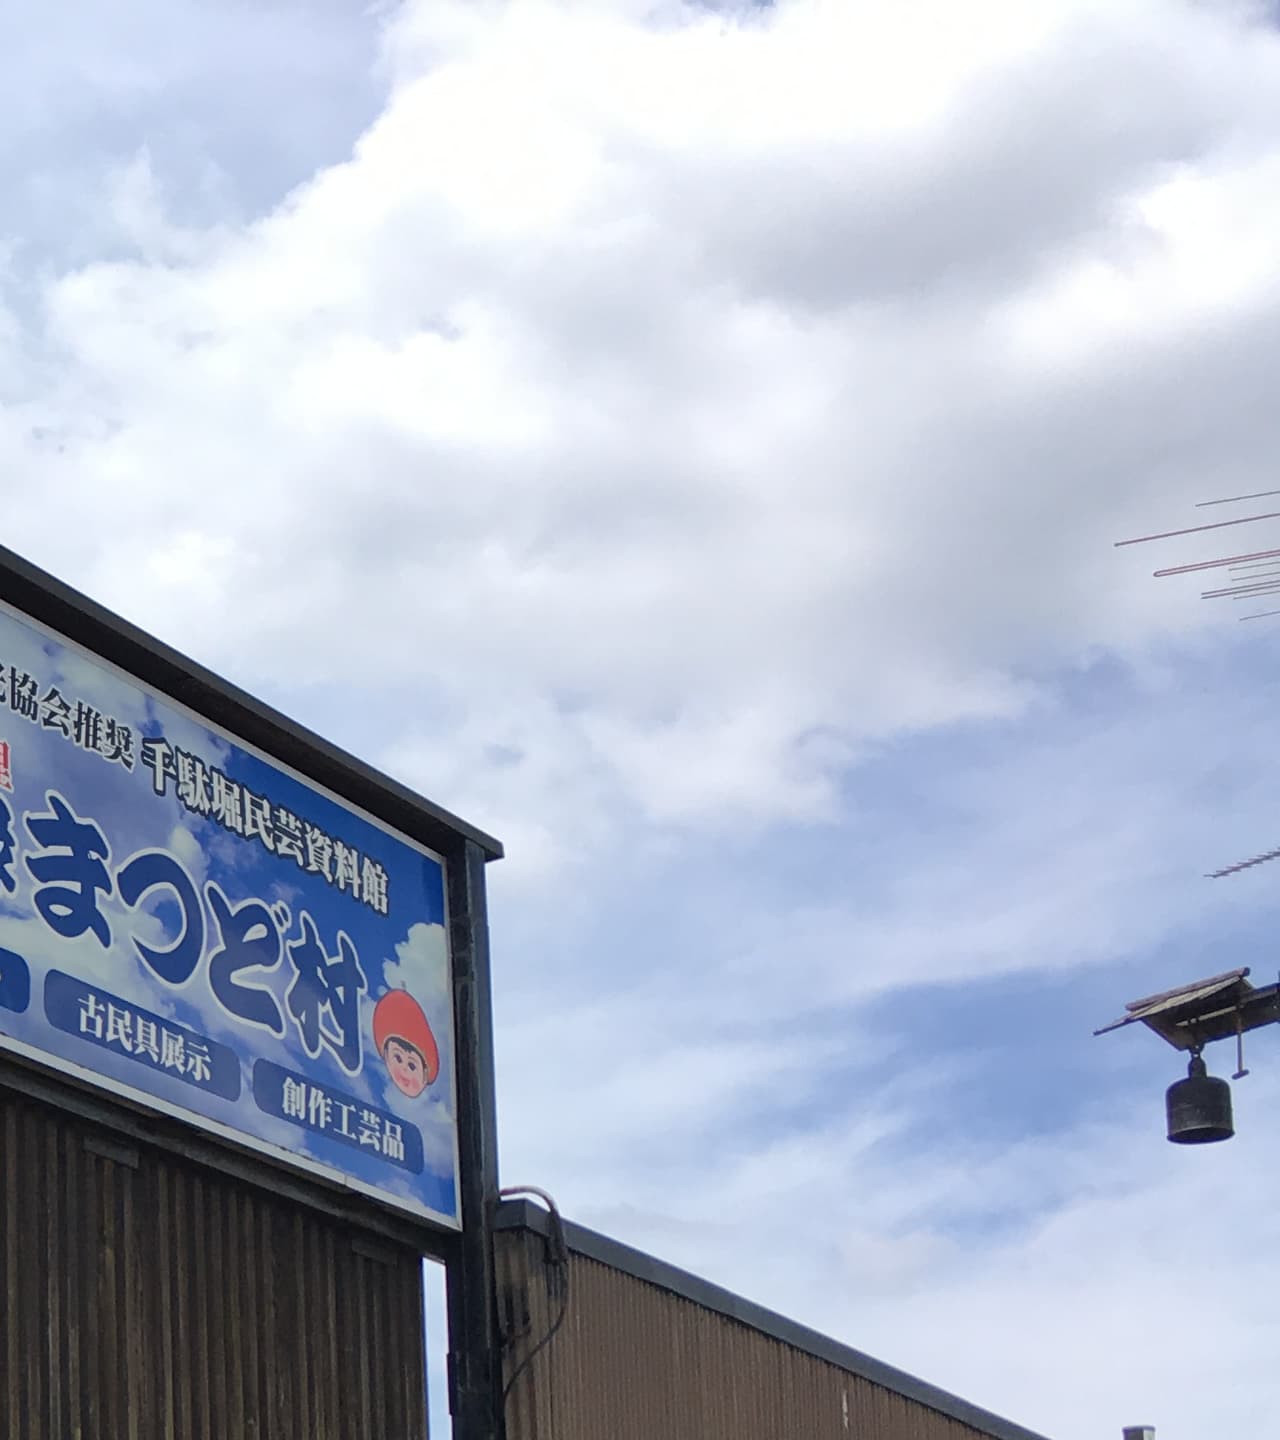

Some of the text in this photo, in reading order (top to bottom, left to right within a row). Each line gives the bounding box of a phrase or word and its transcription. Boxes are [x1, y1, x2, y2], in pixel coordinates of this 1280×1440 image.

[140, 735, 390, 916] 千駄堀民芸資料館
[78, 993, 213, 1084] 古民具展示
[282, 1076, 405, 1162] 創作工芸品
